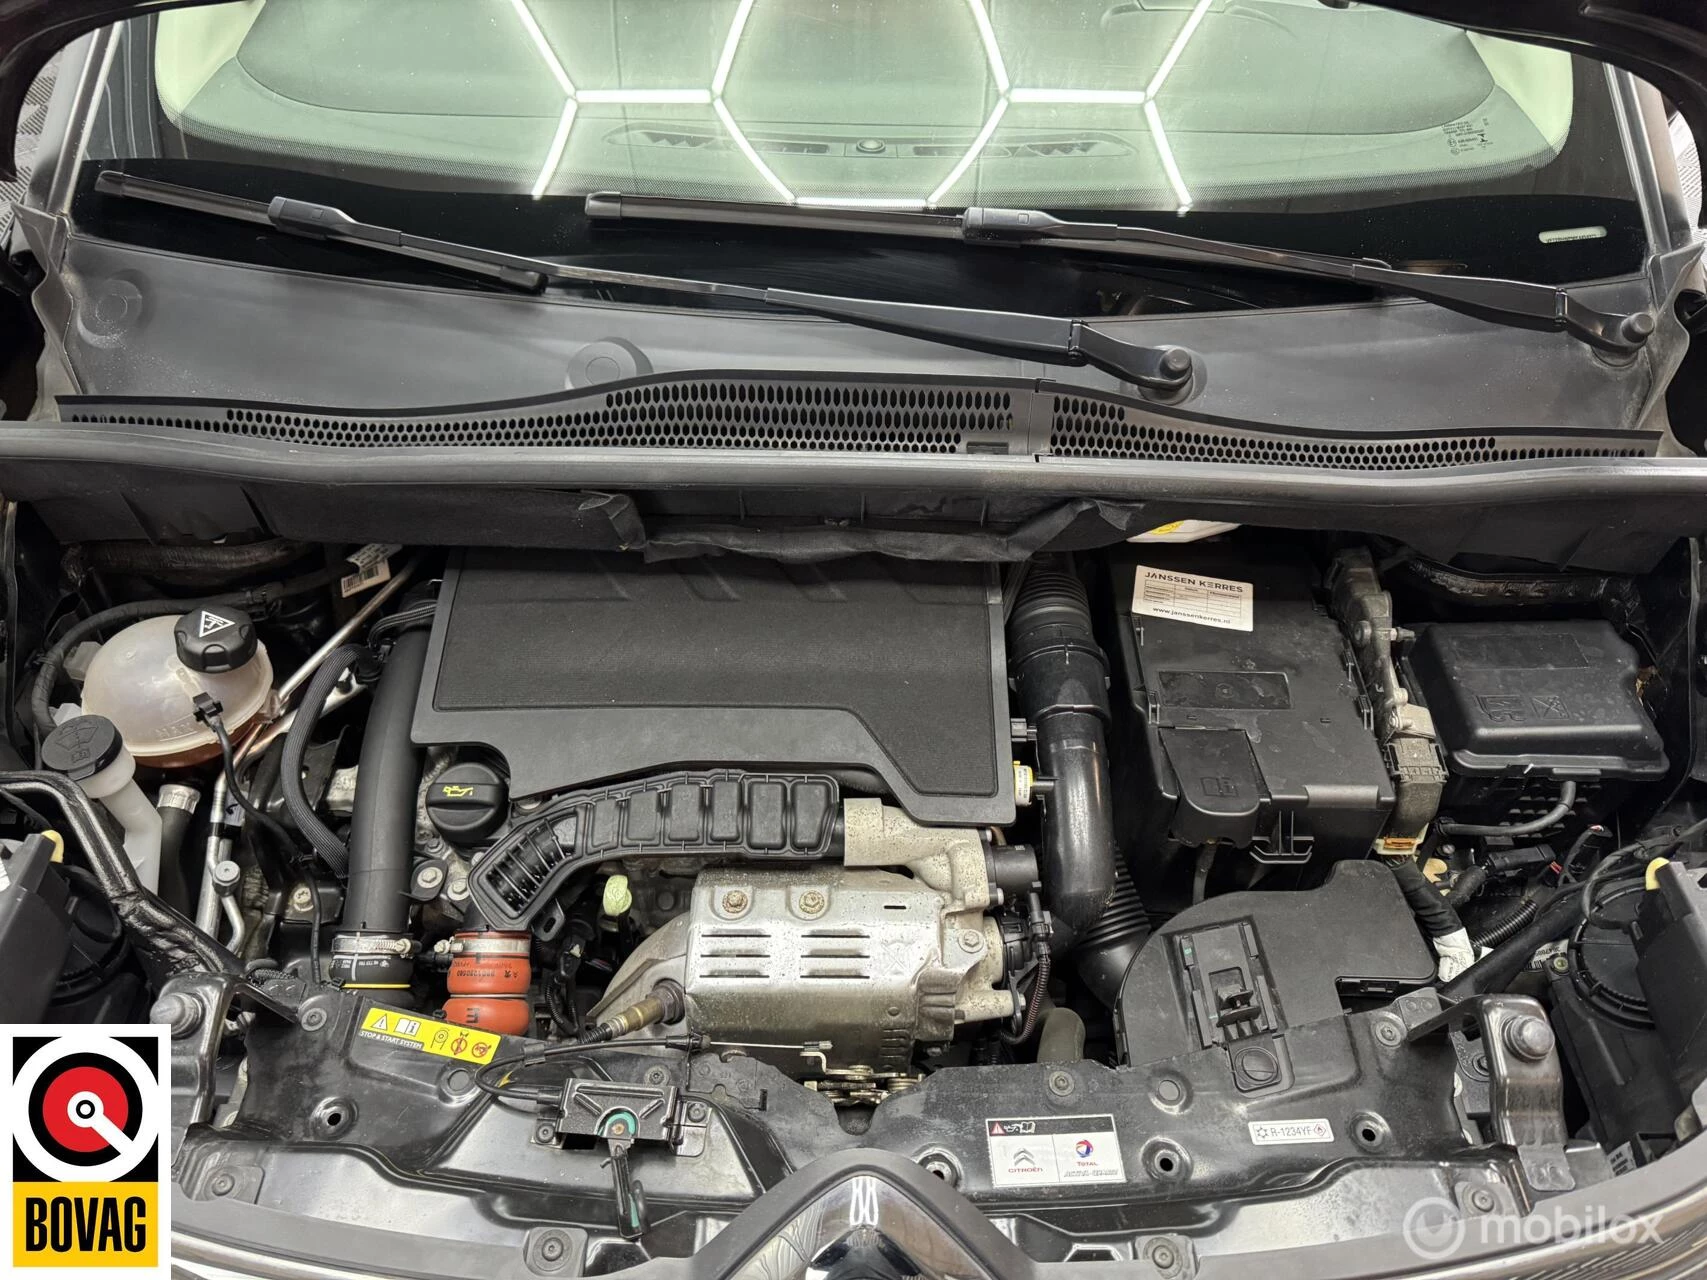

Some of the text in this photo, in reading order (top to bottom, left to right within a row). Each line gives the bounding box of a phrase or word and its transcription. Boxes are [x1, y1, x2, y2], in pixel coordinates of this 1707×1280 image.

[1145, 572, 1243, 593] JANSSEN KERRES
[1153, 607, 1231, 624] www.janssenkerres.nl
[359, 1030, 376, 1039] STOP
[381, 1035, 399, 1045] START
[400, 1039, 423, 1049] SYSTEM
